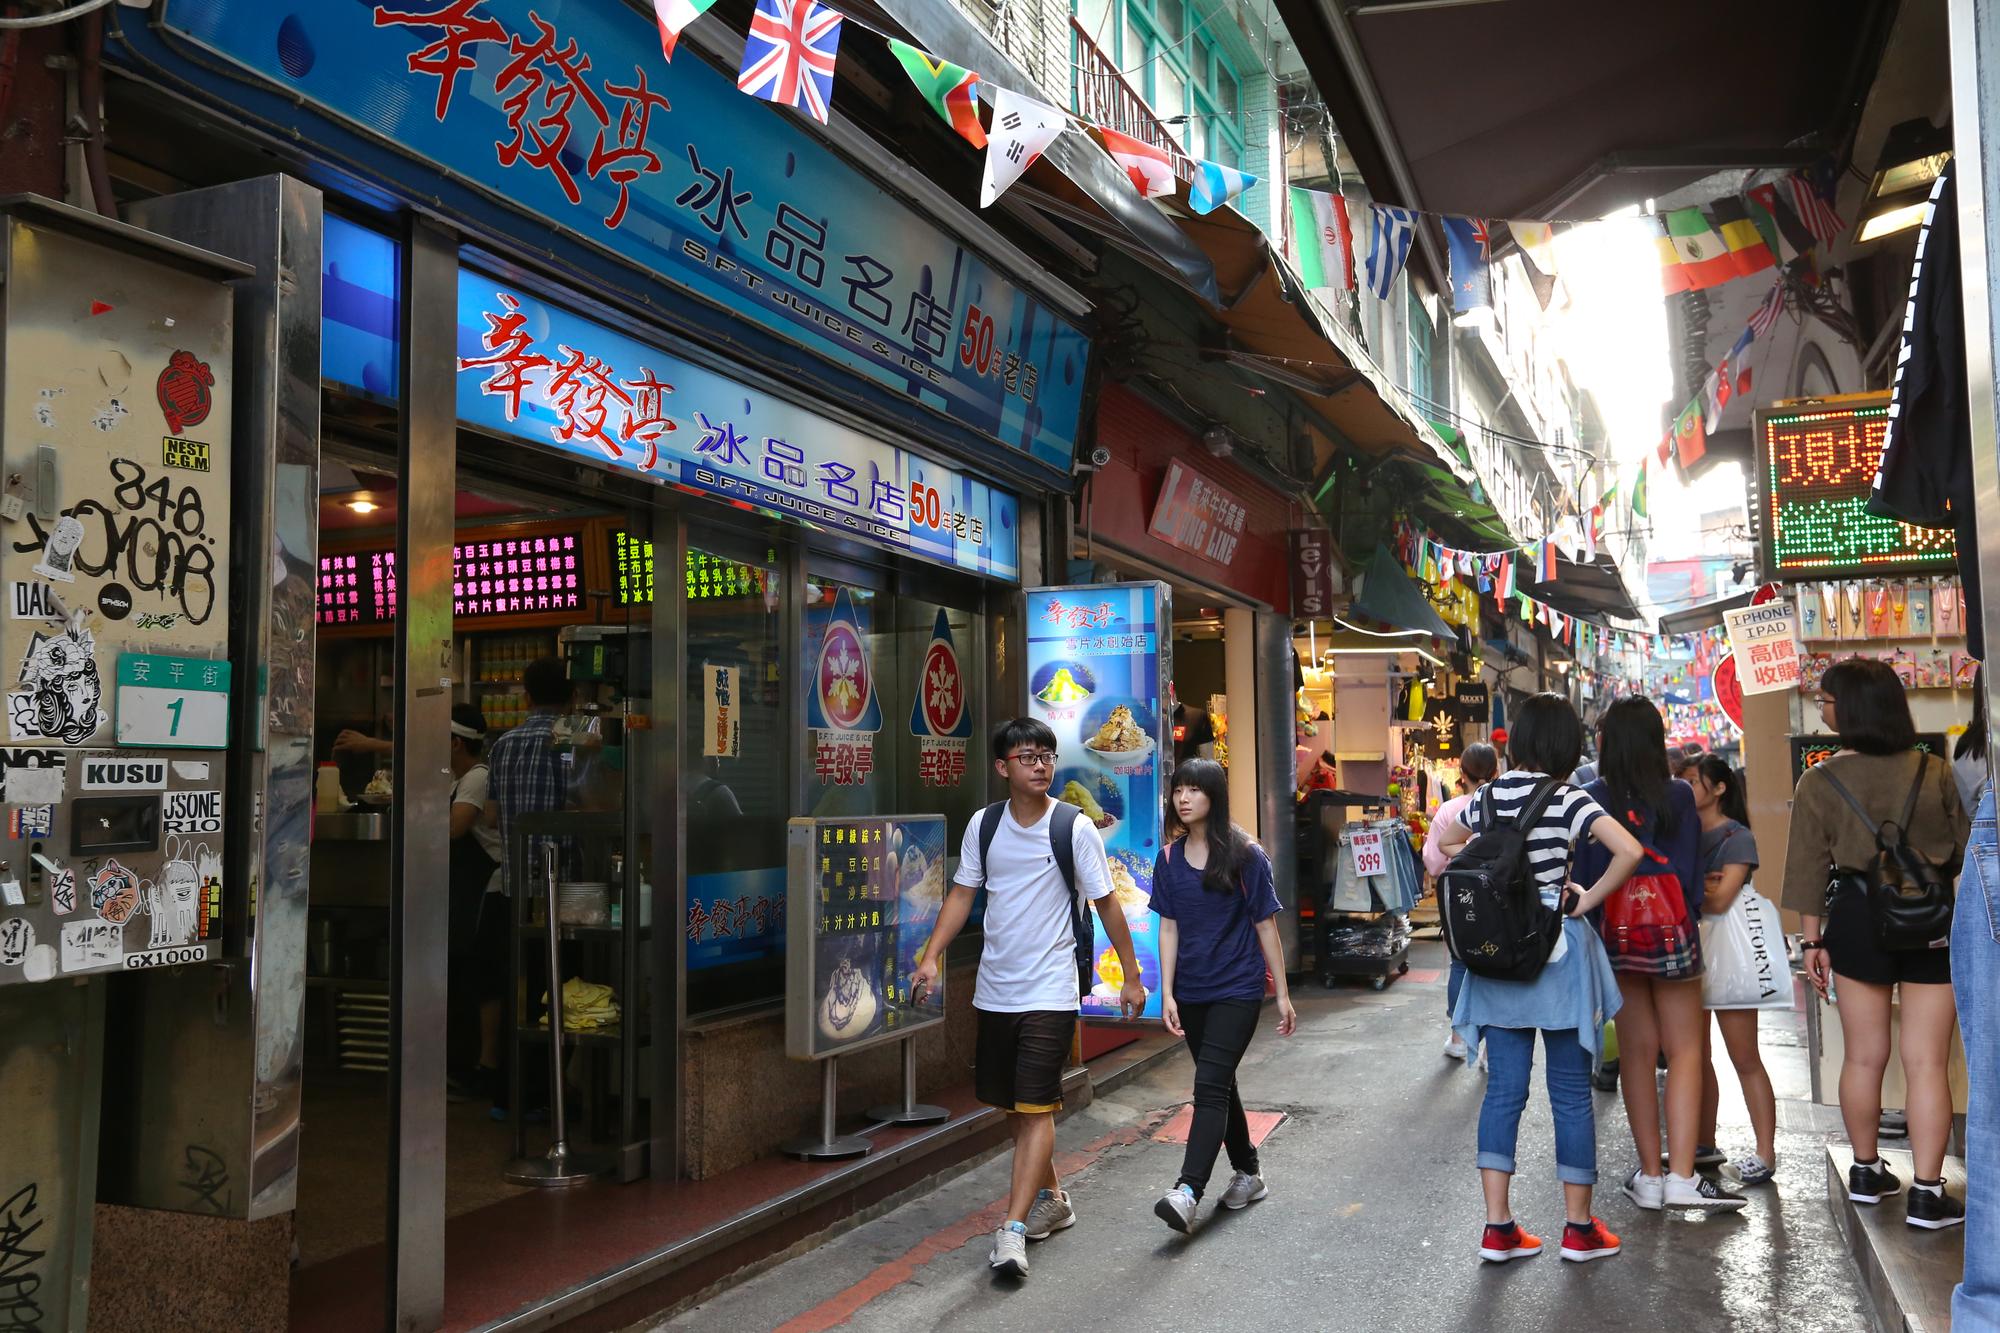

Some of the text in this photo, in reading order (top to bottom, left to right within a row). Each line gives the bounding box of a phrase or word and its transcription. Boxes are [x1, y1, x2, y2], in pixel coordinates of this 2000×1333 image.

[676, 143, 952, 358] 冰品名店
[771, 291, 864, 345] JUICE
[871, 342, 891, 358] &
[900, 355, 942, 385] ICE
[457, 293, 678, 472] 辛發亭
[166, 452, 208, 470] C.G.M
[168, 440, 205, 456] NEST
[693, 411, 906, 524] 冰品名店
[763, 491, 843, 522] JUICE
[844, 516, 858, 527] &
[866, 521, 902, 542] ICE
[1205, 526, 1238, 566] LINE
[1732, 606, 1793, 626] IPHONE
[1745, 621, 1787, 639] IPAD
[1748, 639, 1797, 665] 高價
[132, 660, 219, 687] 安平街
[1754, 661, 1800, 686] 收購
[167, 698, 186, 737] 1
[836, 732, 854, 742] JUICE
[861, 734, 872, 742] ICE
[935, 739, 951, 748] JUICE
[87, 764, 163, 784] KUSU
[816, 743, 874, 786] 辛發亭
[920, 748, 967, 787] 辛發亭
[163, 792, 221, 819] JSONE
[163, 819, 221, 834] R10
[1358, 852, 1380, 872] 399
[126, 948, 205, 968] GX1000
[1743, 892, 1777, 999] ALIFORNIA
